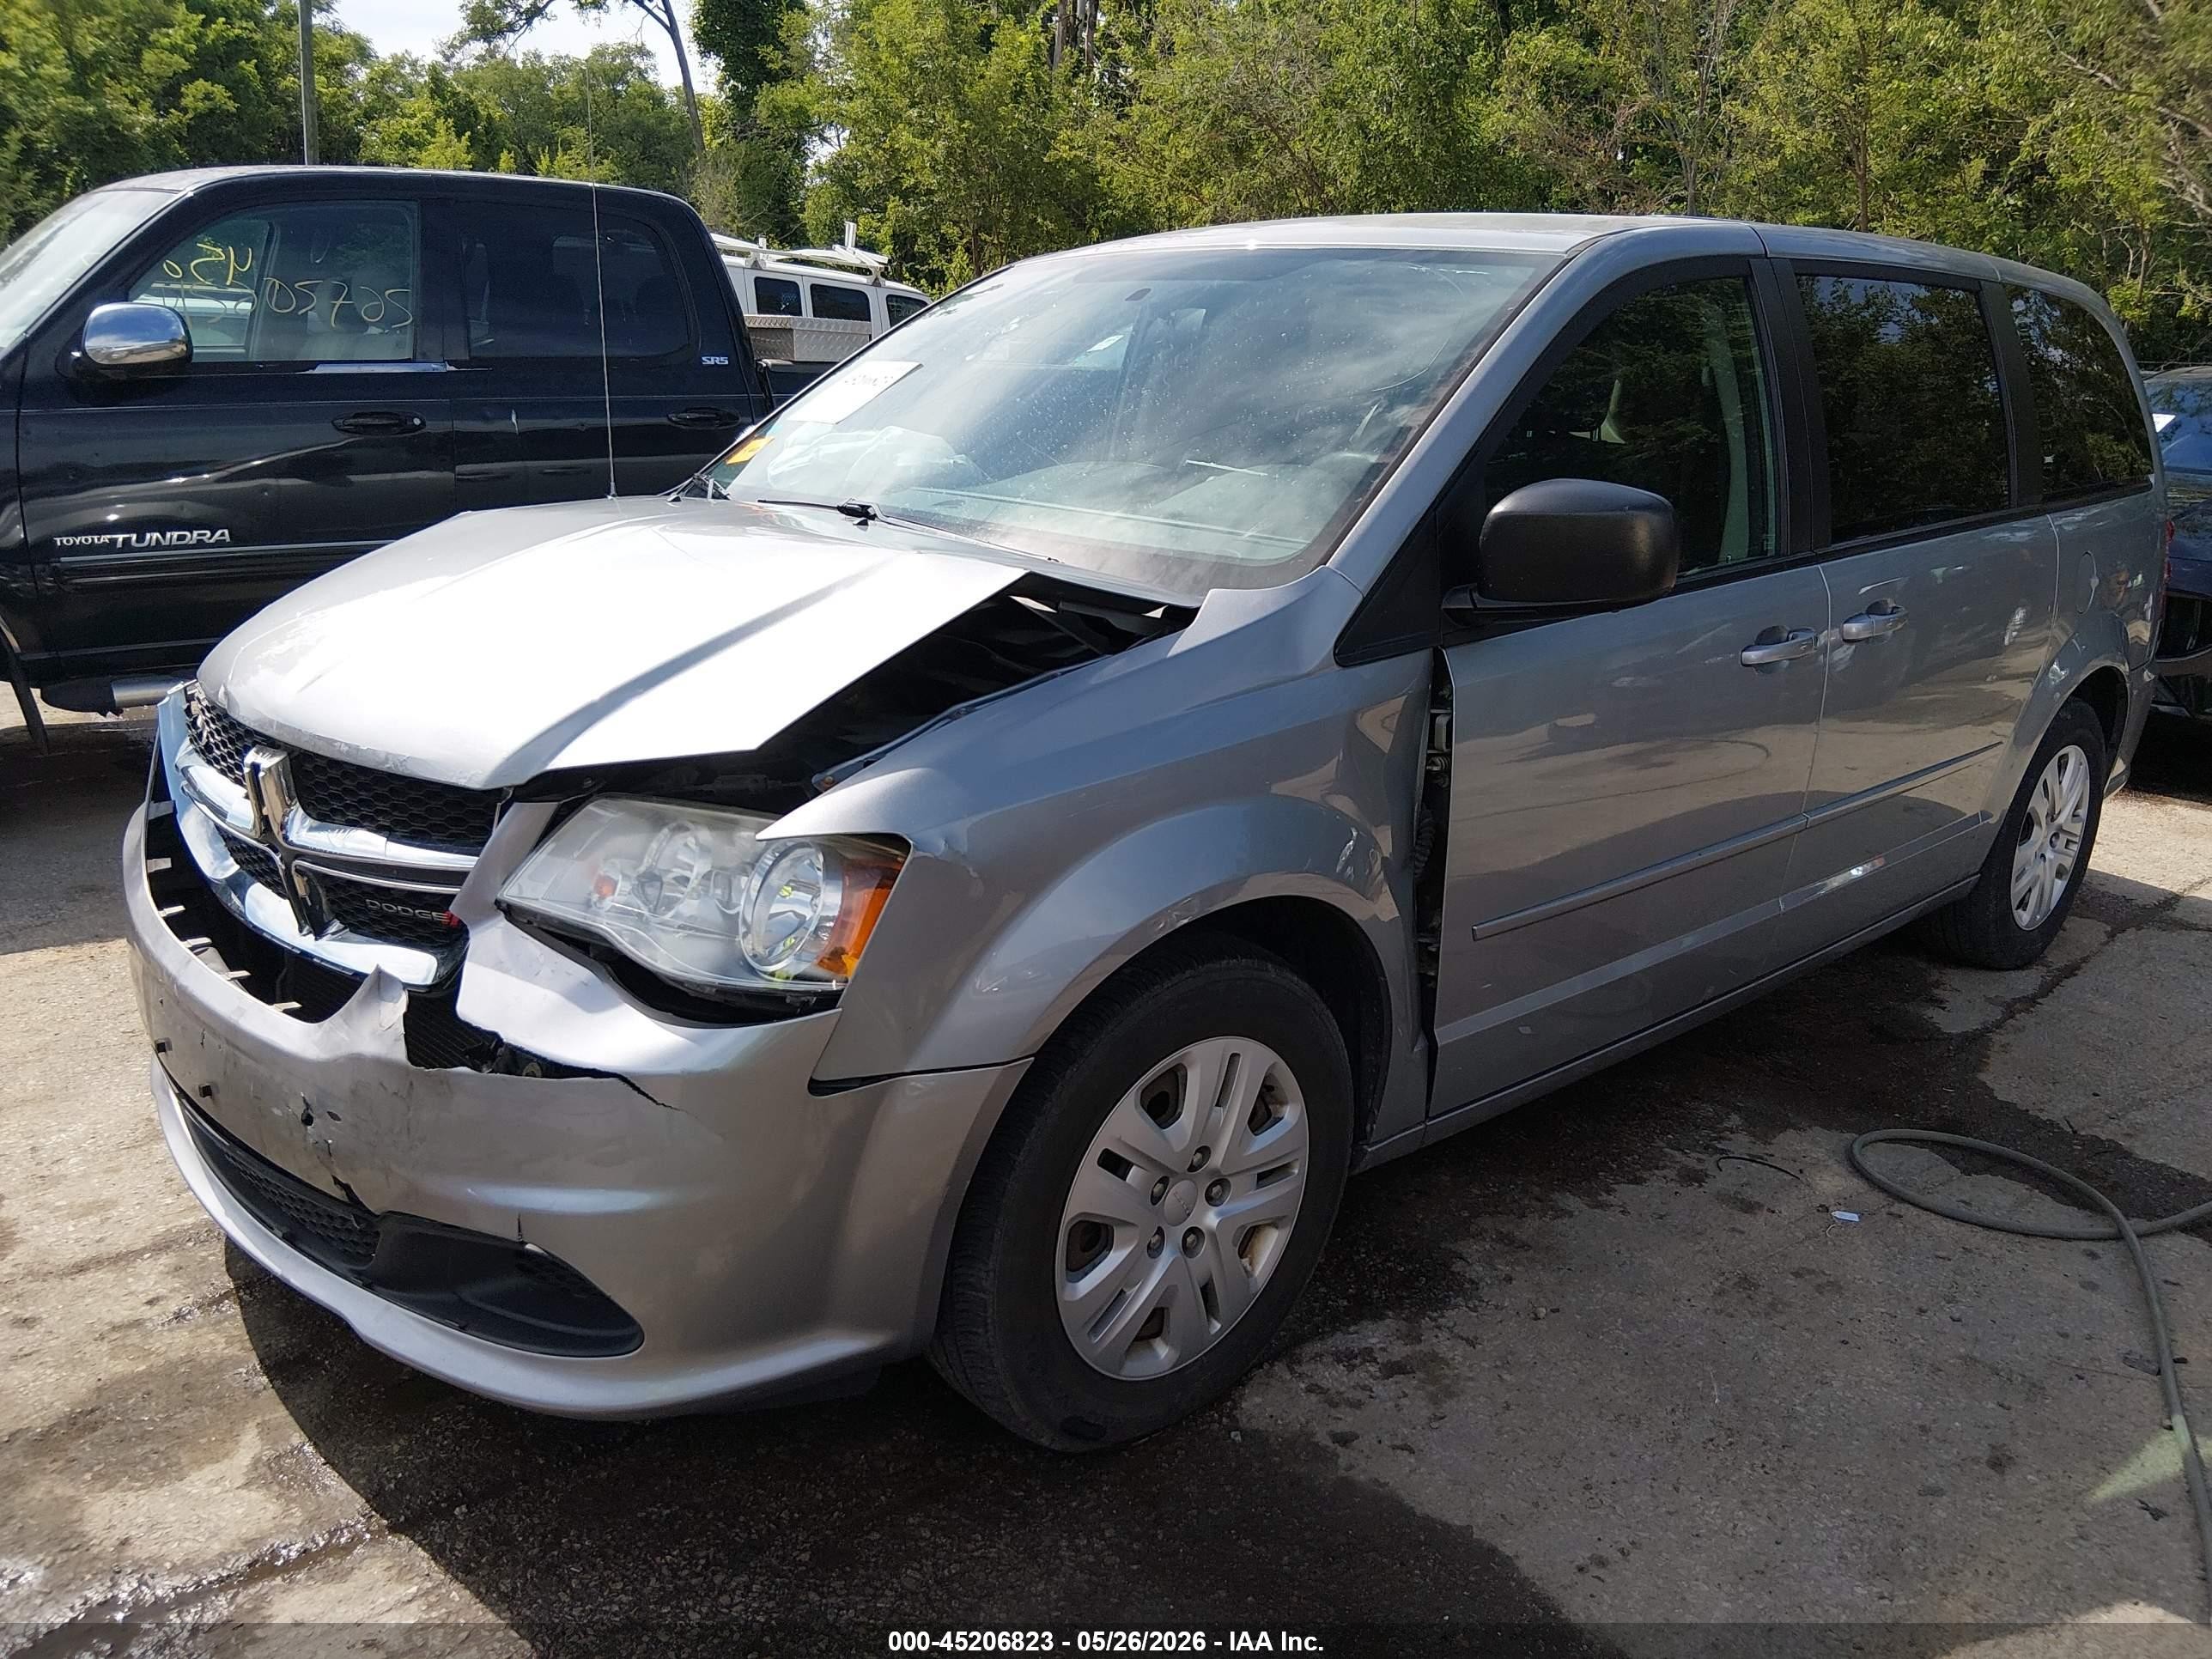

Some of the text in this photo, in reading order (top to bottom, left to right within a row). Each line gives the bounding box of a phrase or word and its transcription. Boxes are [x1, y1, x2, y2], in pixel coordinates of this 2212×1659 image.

[701, 356, 729, 365] SR5
[53, 528, 231, 549] TOYOTA TUNDRA
[365, 898, 451, 922] DODGE
